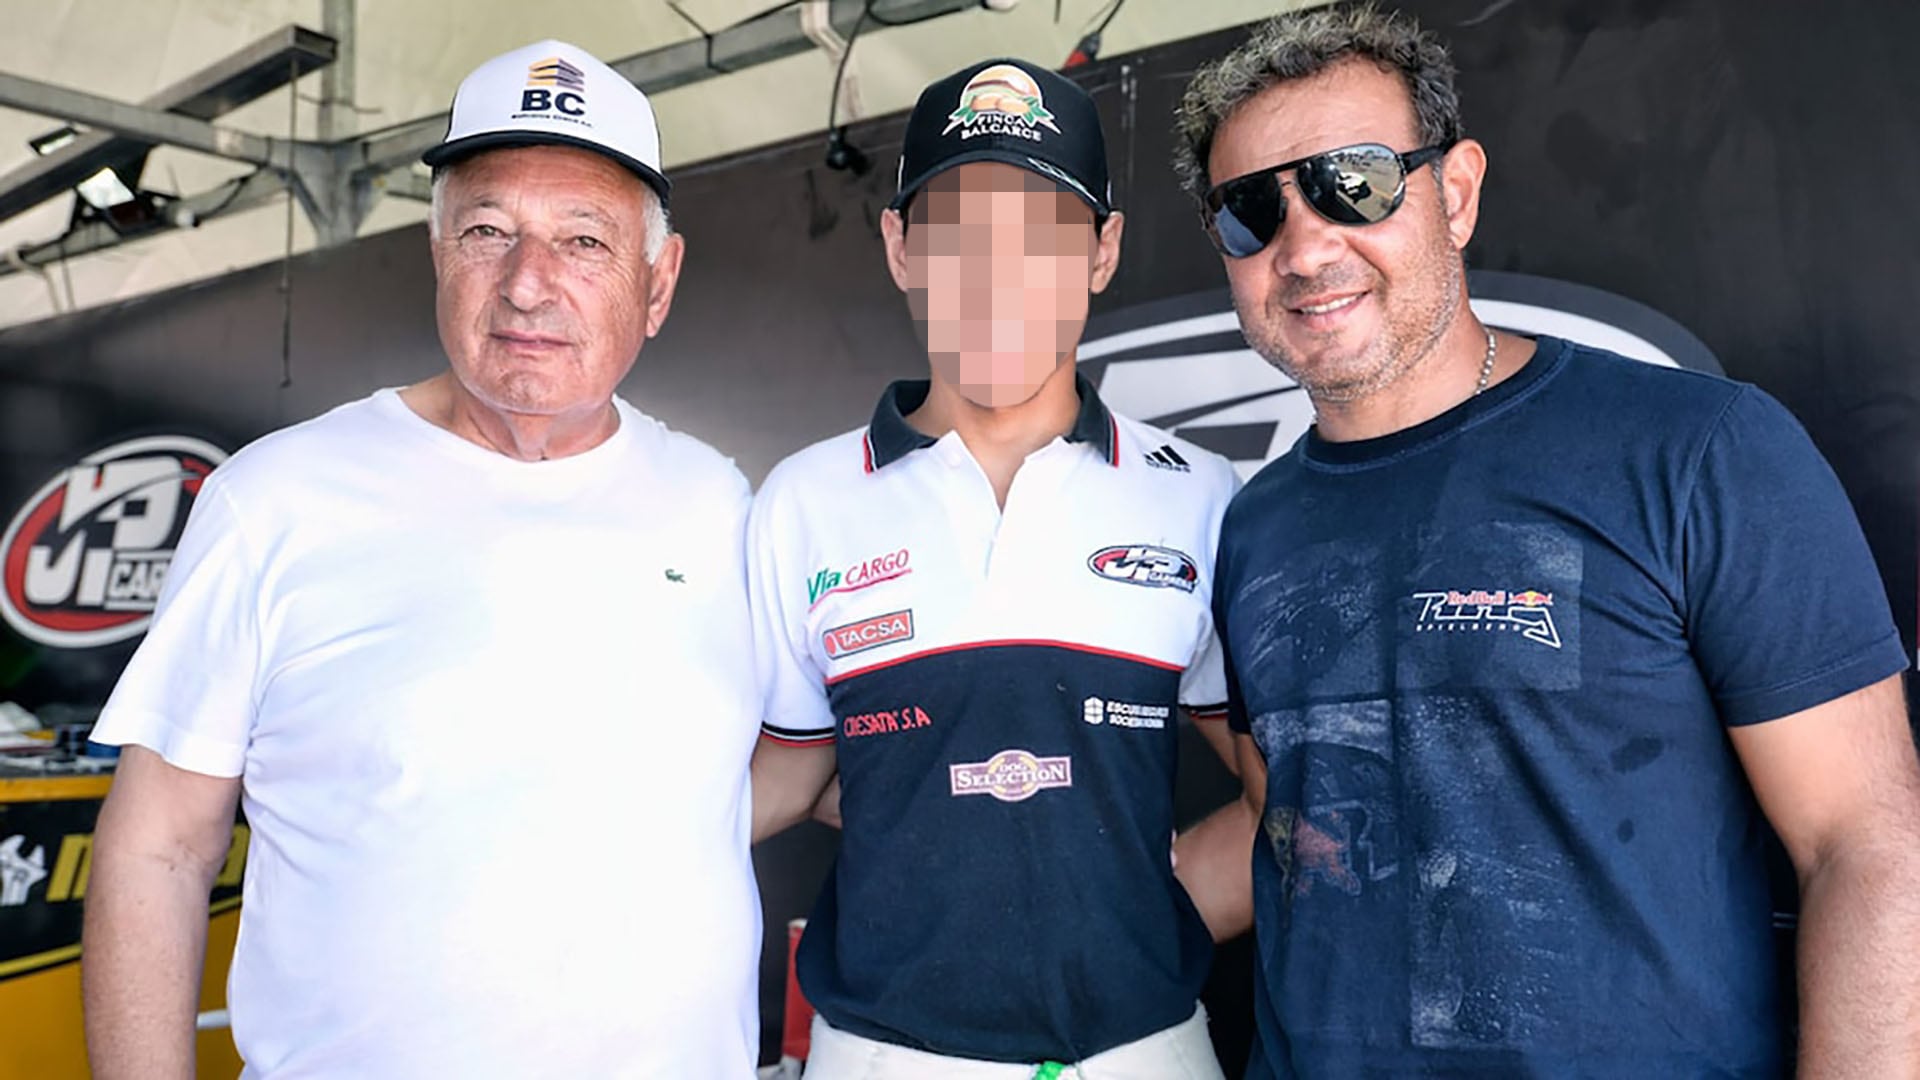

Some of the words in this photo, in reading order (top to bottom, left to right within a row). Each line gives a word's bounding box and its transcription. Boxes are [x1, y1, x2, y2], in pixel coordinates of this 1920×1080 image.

[521, 90, 585, 116] BC
[961, 125, 1042, 141] BALCARCE
[977, 113, 1025, 127] FINCA
[845, 548, 909, 585] CARGO
[838, 618, 907, 648] TACSA
